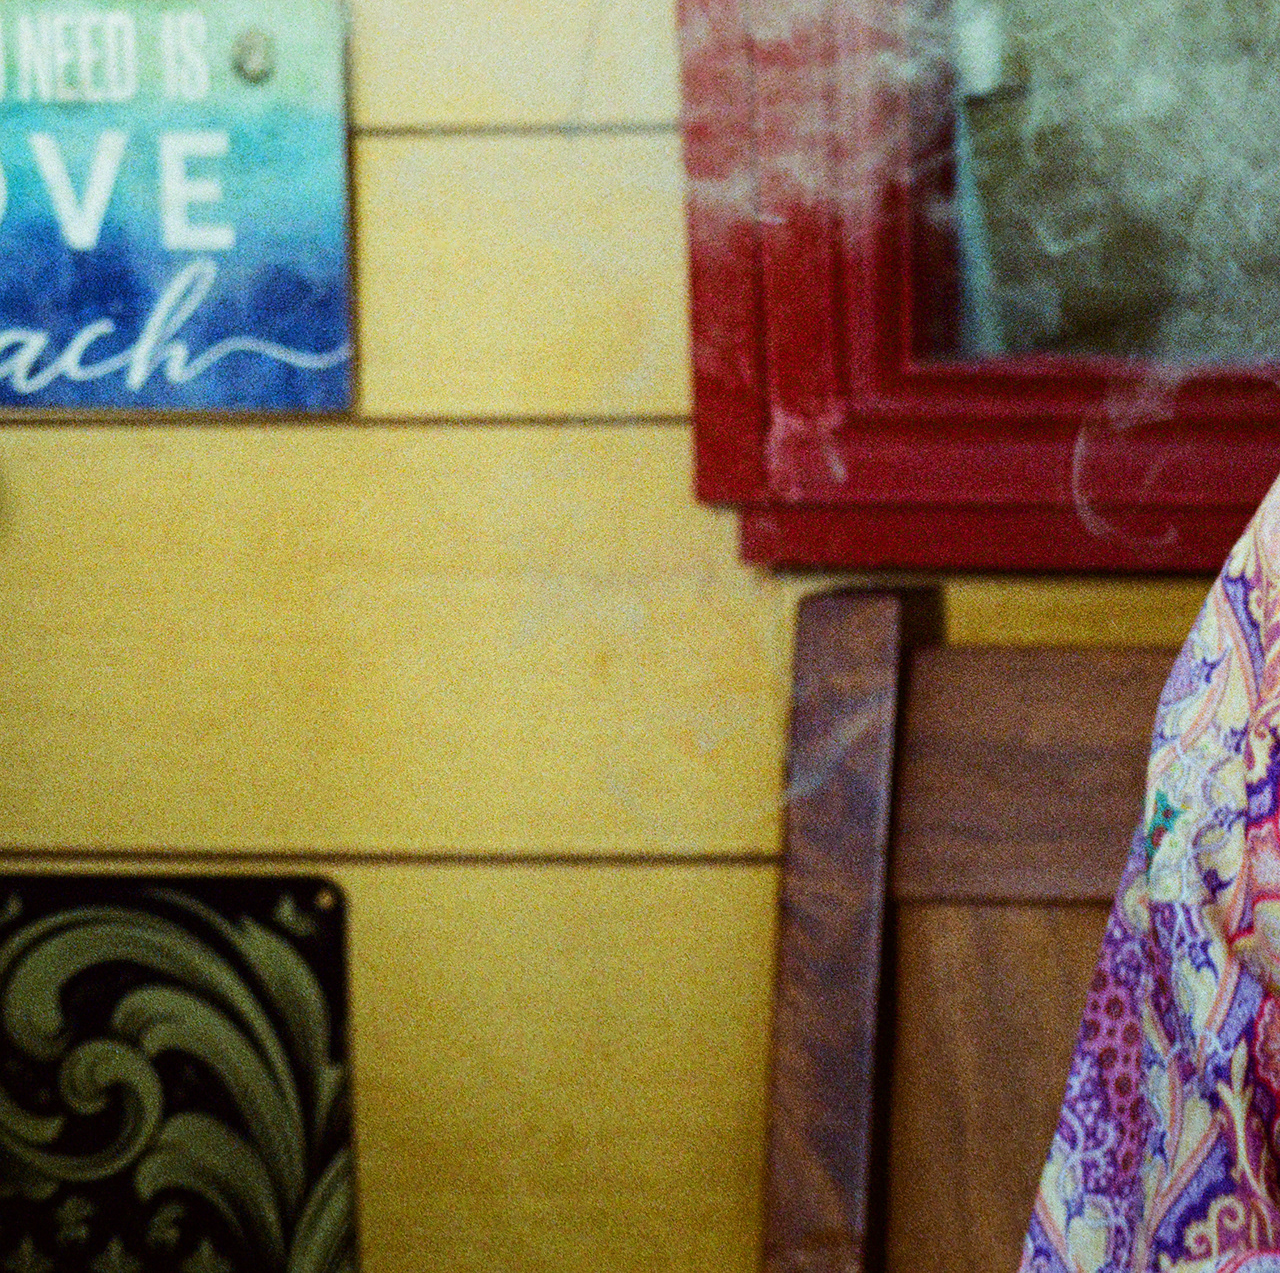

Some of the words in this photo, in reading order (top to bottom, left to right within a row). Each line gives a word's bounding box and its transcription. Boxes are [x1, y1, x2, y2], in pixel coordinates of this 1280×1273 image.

[16, 9, 138, 103] NEED
[160, 11, 211, 101] IS
[0, 130, 237, 252] VE
